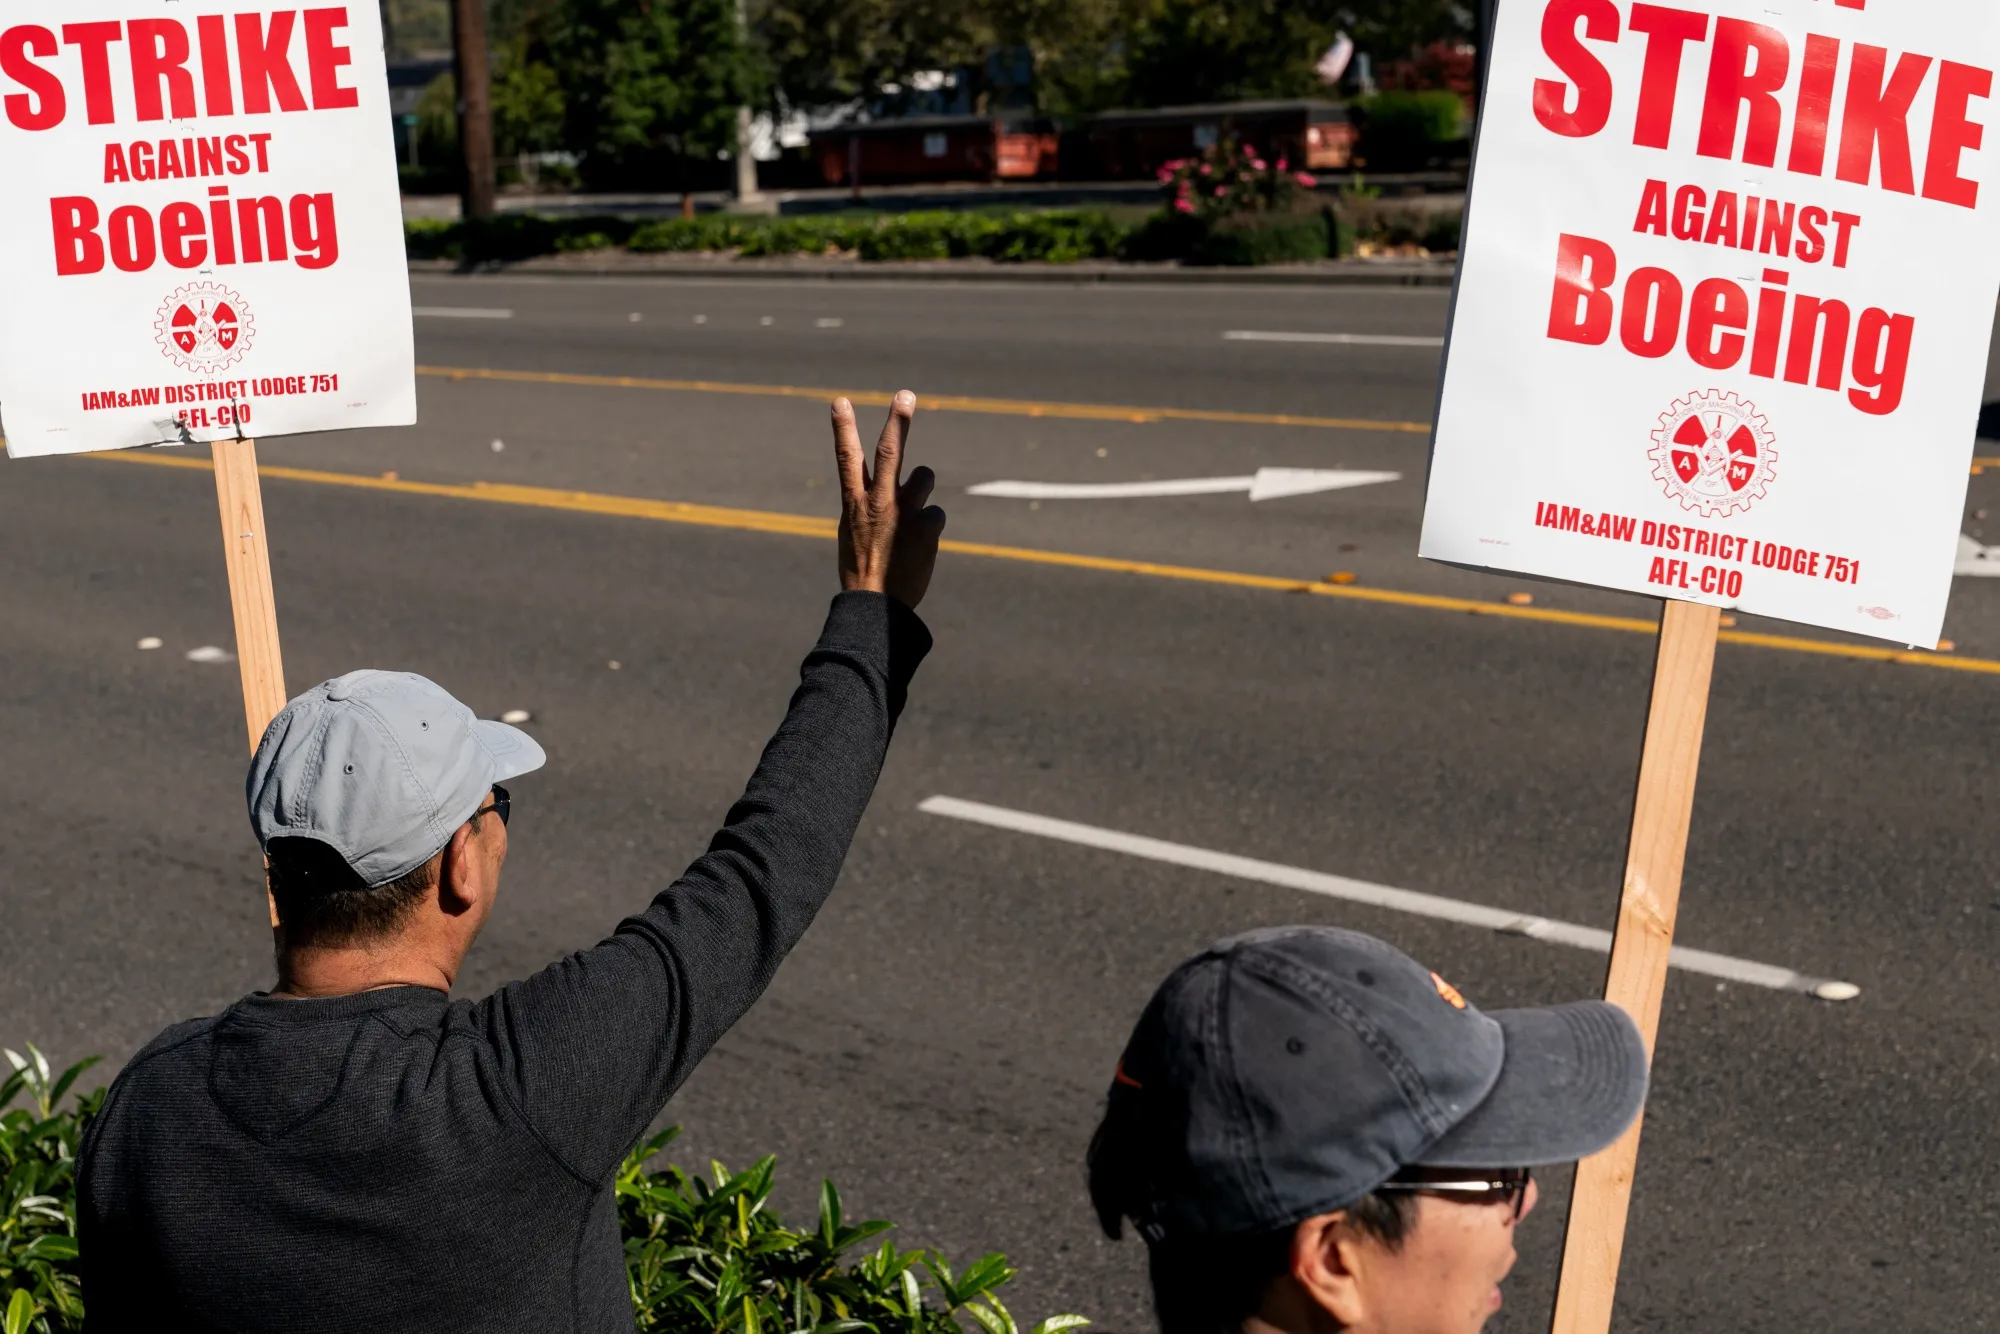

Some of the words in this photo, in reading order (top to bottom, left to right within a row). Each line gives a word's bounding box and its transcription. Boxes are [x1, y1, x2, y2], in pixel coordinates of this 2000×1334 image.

[0, 6, 359, 132] STRIKE
[1532, 0, 1993, 209] STRIKE
[104, 133, 272, 184] AGAINST
[50, 185, 339, 276] Boeing
[1632, 178, 1861, 268] AGAINST
[1546, 233, 1915, 416] Boeing
[82, 387, 160, 411] IAM&AW
[164, 380, 247, 404] DISTRICT
[252, 376, 307, 397] LODGE
[310, 374, 338, 393] 751
[1678, 456, 1692, 470] A
[1731, 465, 1747, 481] M
[1535, 502, 1637, 542] IAM&AW
[1640, 520, 1749, 562] DISTRICT
[1751, 540, 1820, 577] LODGE
[1824, 554, 1860, 584] 751
[1648, 556, 1743, 598] AFL-CIO
